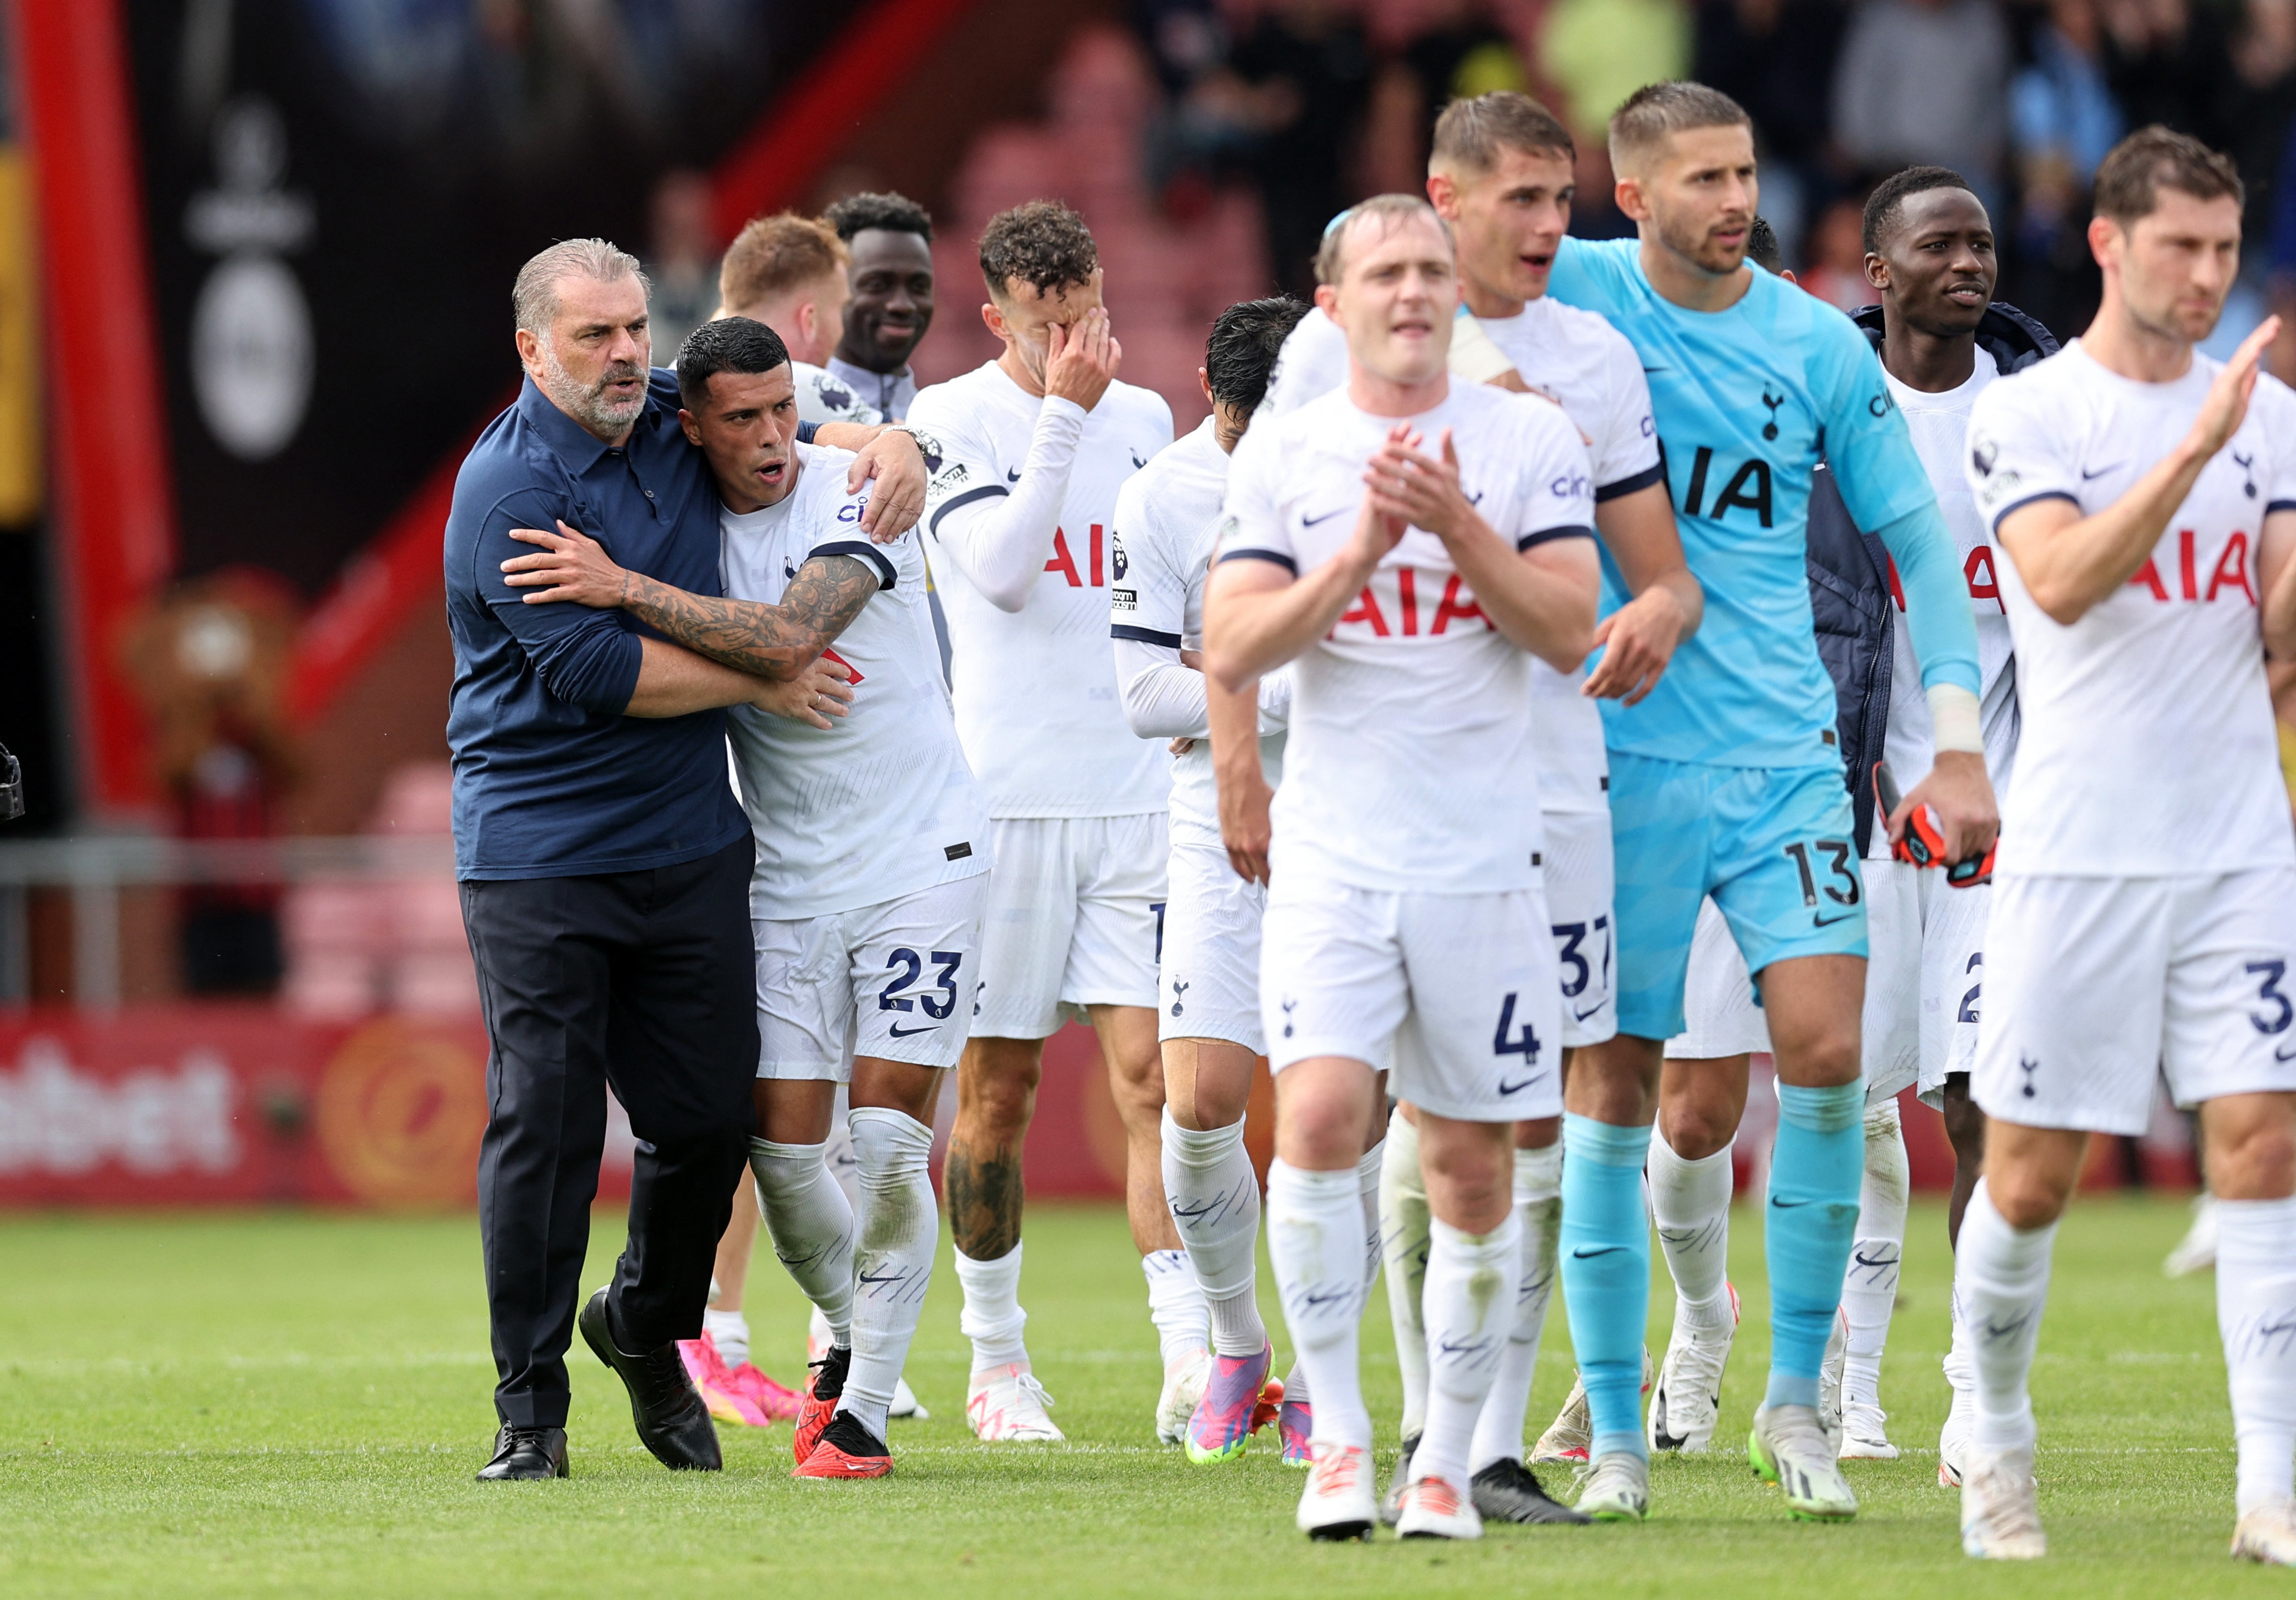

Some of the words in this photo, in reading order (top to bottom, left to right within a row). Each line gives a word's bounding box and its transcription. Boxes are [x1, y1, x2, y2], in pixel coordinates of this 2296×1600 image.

[1657, 435, 1773, 529] IA
[1783, 839, 1859, 908] 13
[878, 947, 963, 1020] 23
[1551, 913, 1611, 997] 37
[1493, 991, 1542, 1065] 4
[2245, 959, 2294, 1035] 3
